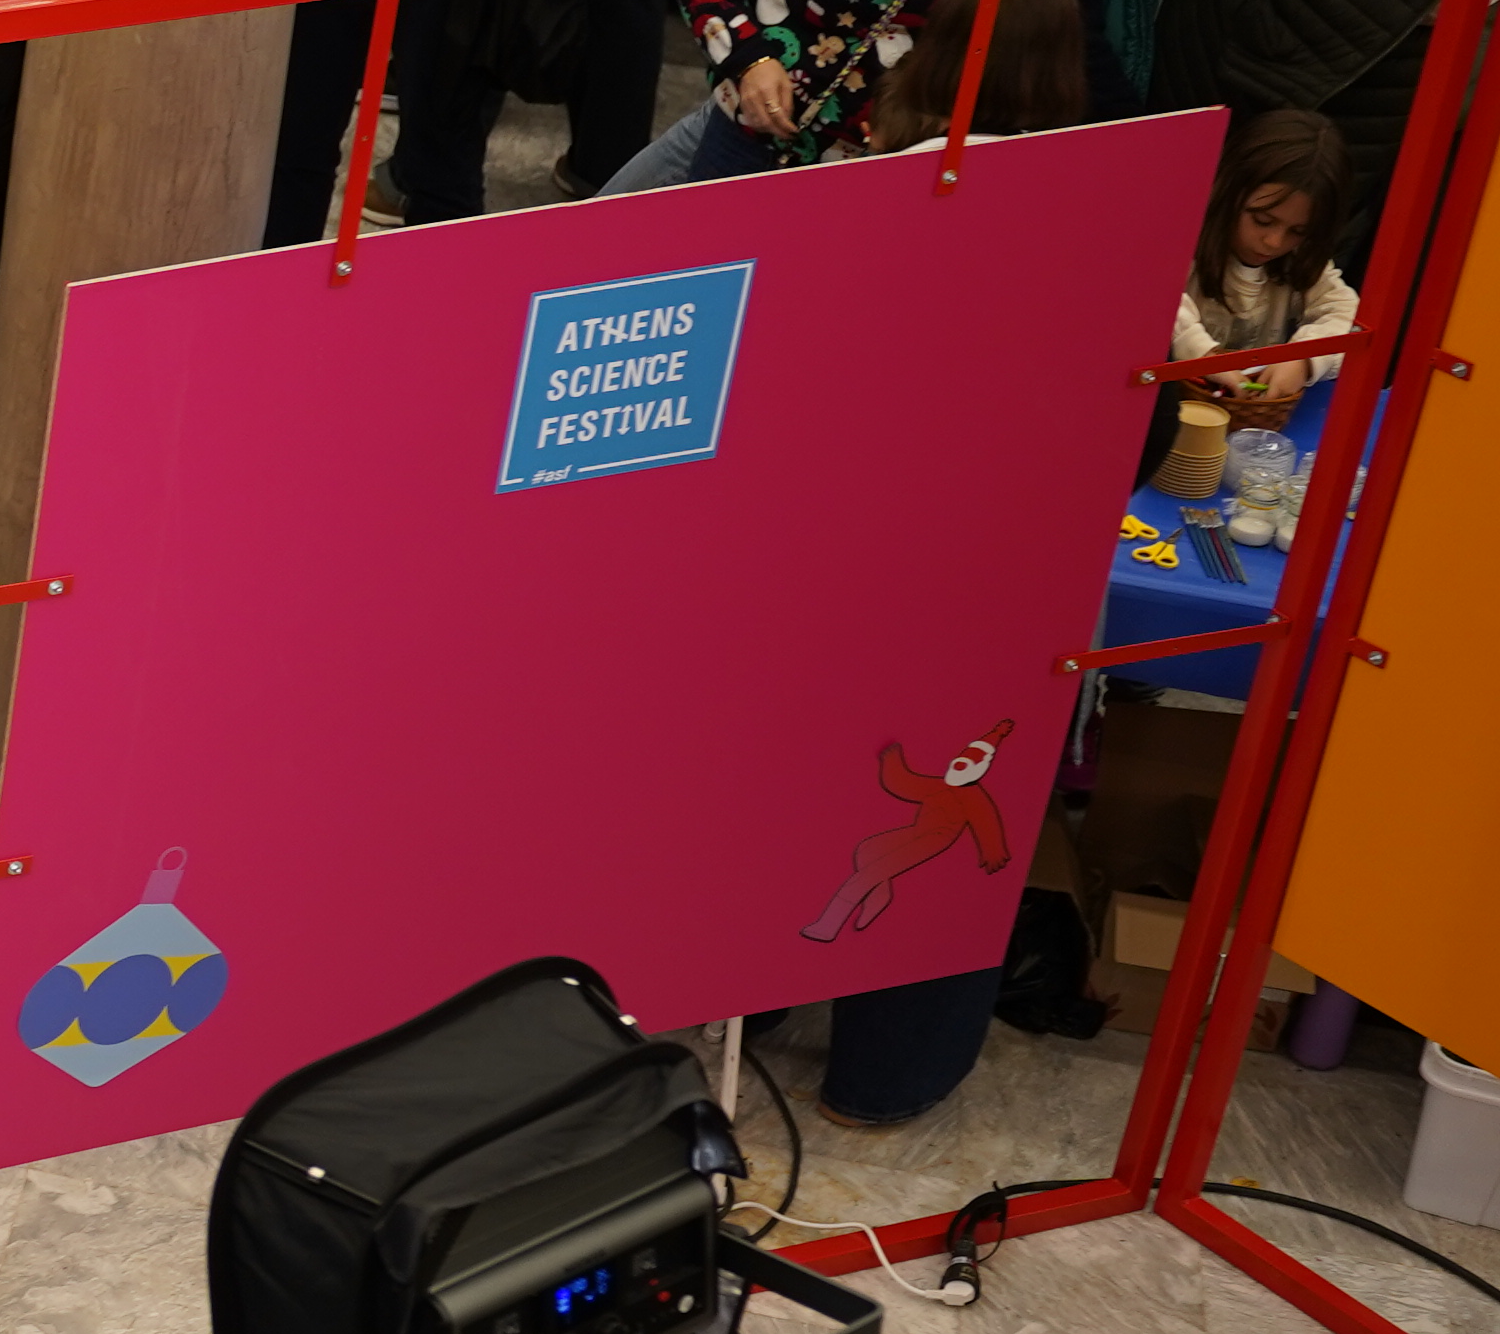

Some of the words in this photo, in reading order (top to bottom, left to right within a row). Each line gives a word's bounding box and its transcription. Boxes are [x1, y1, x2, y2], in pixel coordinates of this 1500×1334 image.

[556, 302, 696, 355] ATHENS
[546, 349, 689, 402] SCIENCE
[537, 395, 693, 449] FESTIVAL
[531, 464, 573, 485] #asf
